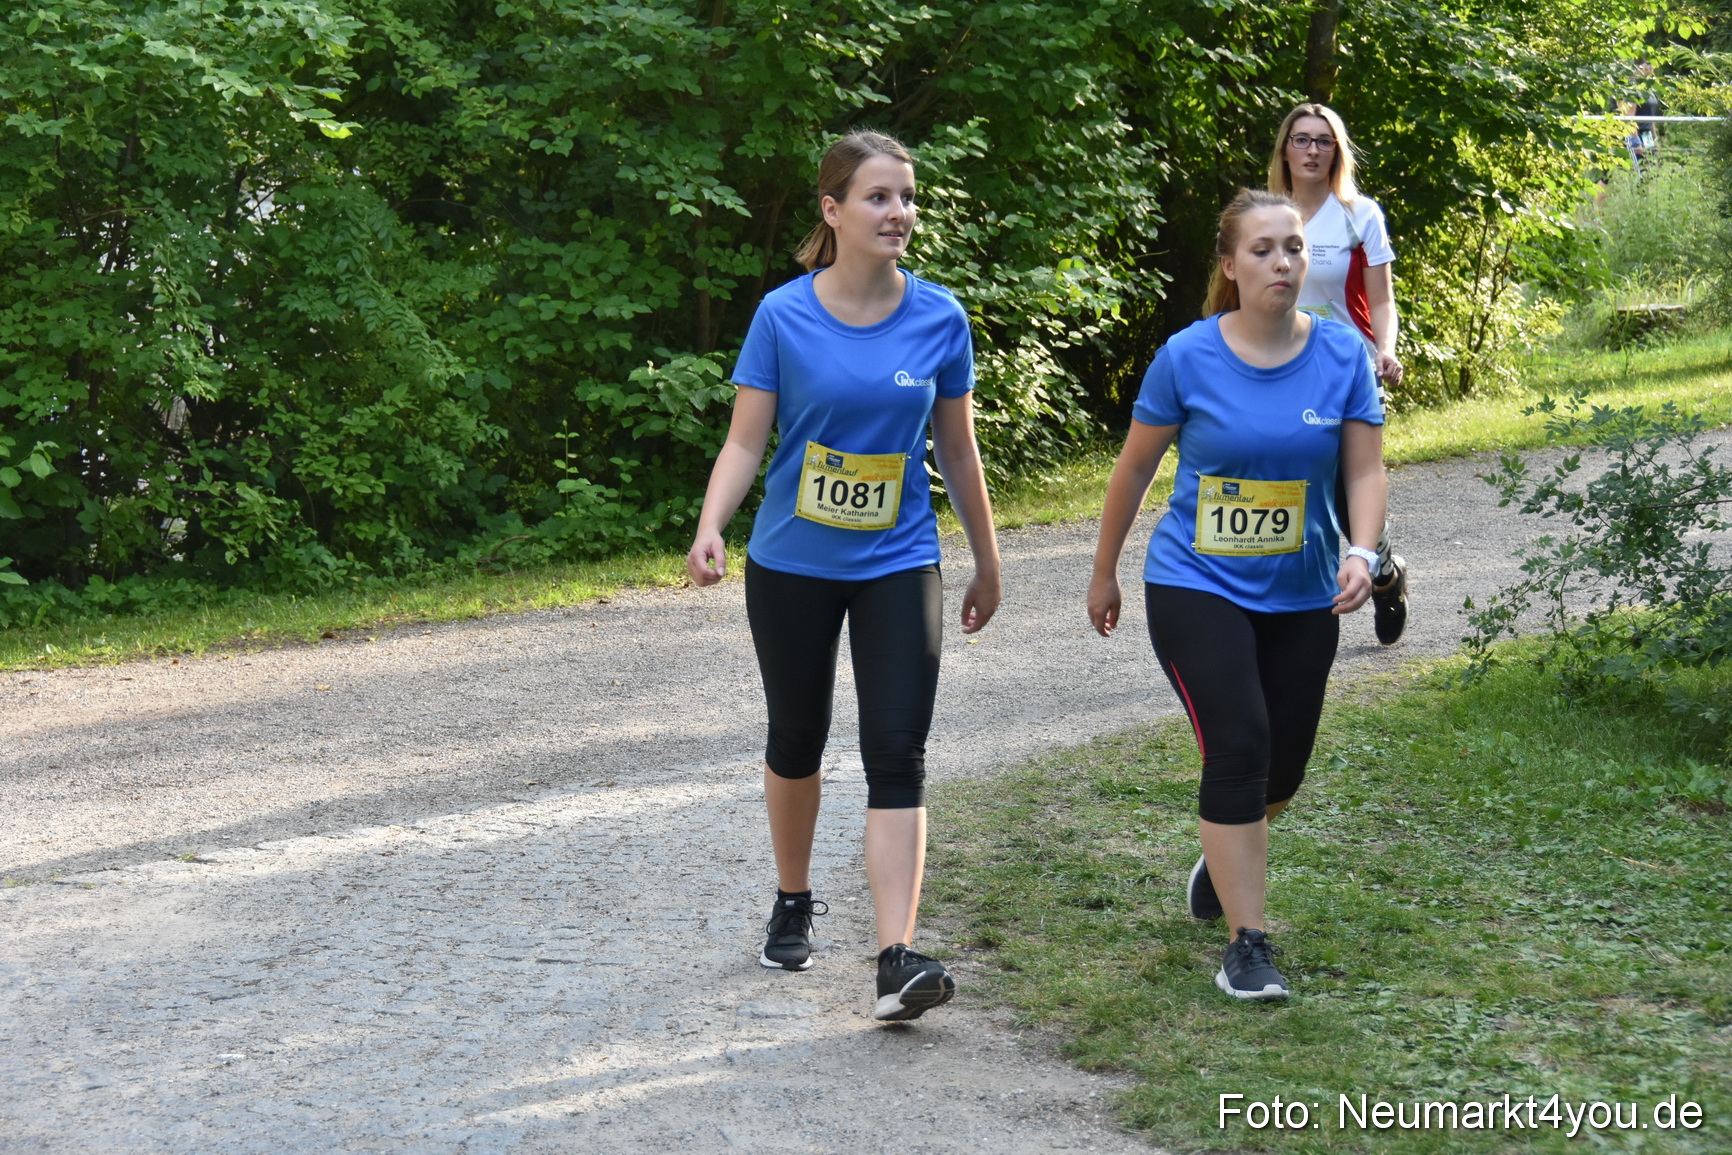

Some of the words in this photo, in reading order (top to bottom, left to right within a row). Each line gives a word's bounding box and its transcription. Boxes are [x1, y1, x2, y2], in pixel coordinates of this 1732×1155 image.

[813, 475, 886, 509] 1081
[1214, 492, 1255, 503] firmenlauf
[817, 503, 839, 514] Meier
[840, 508, 879, 518] Katharina
[1211, 506, 1290, 535] 1079
[1213, 535, 1255, 544] Leonhardt
[1256, 535, 1285, 543] Annika
